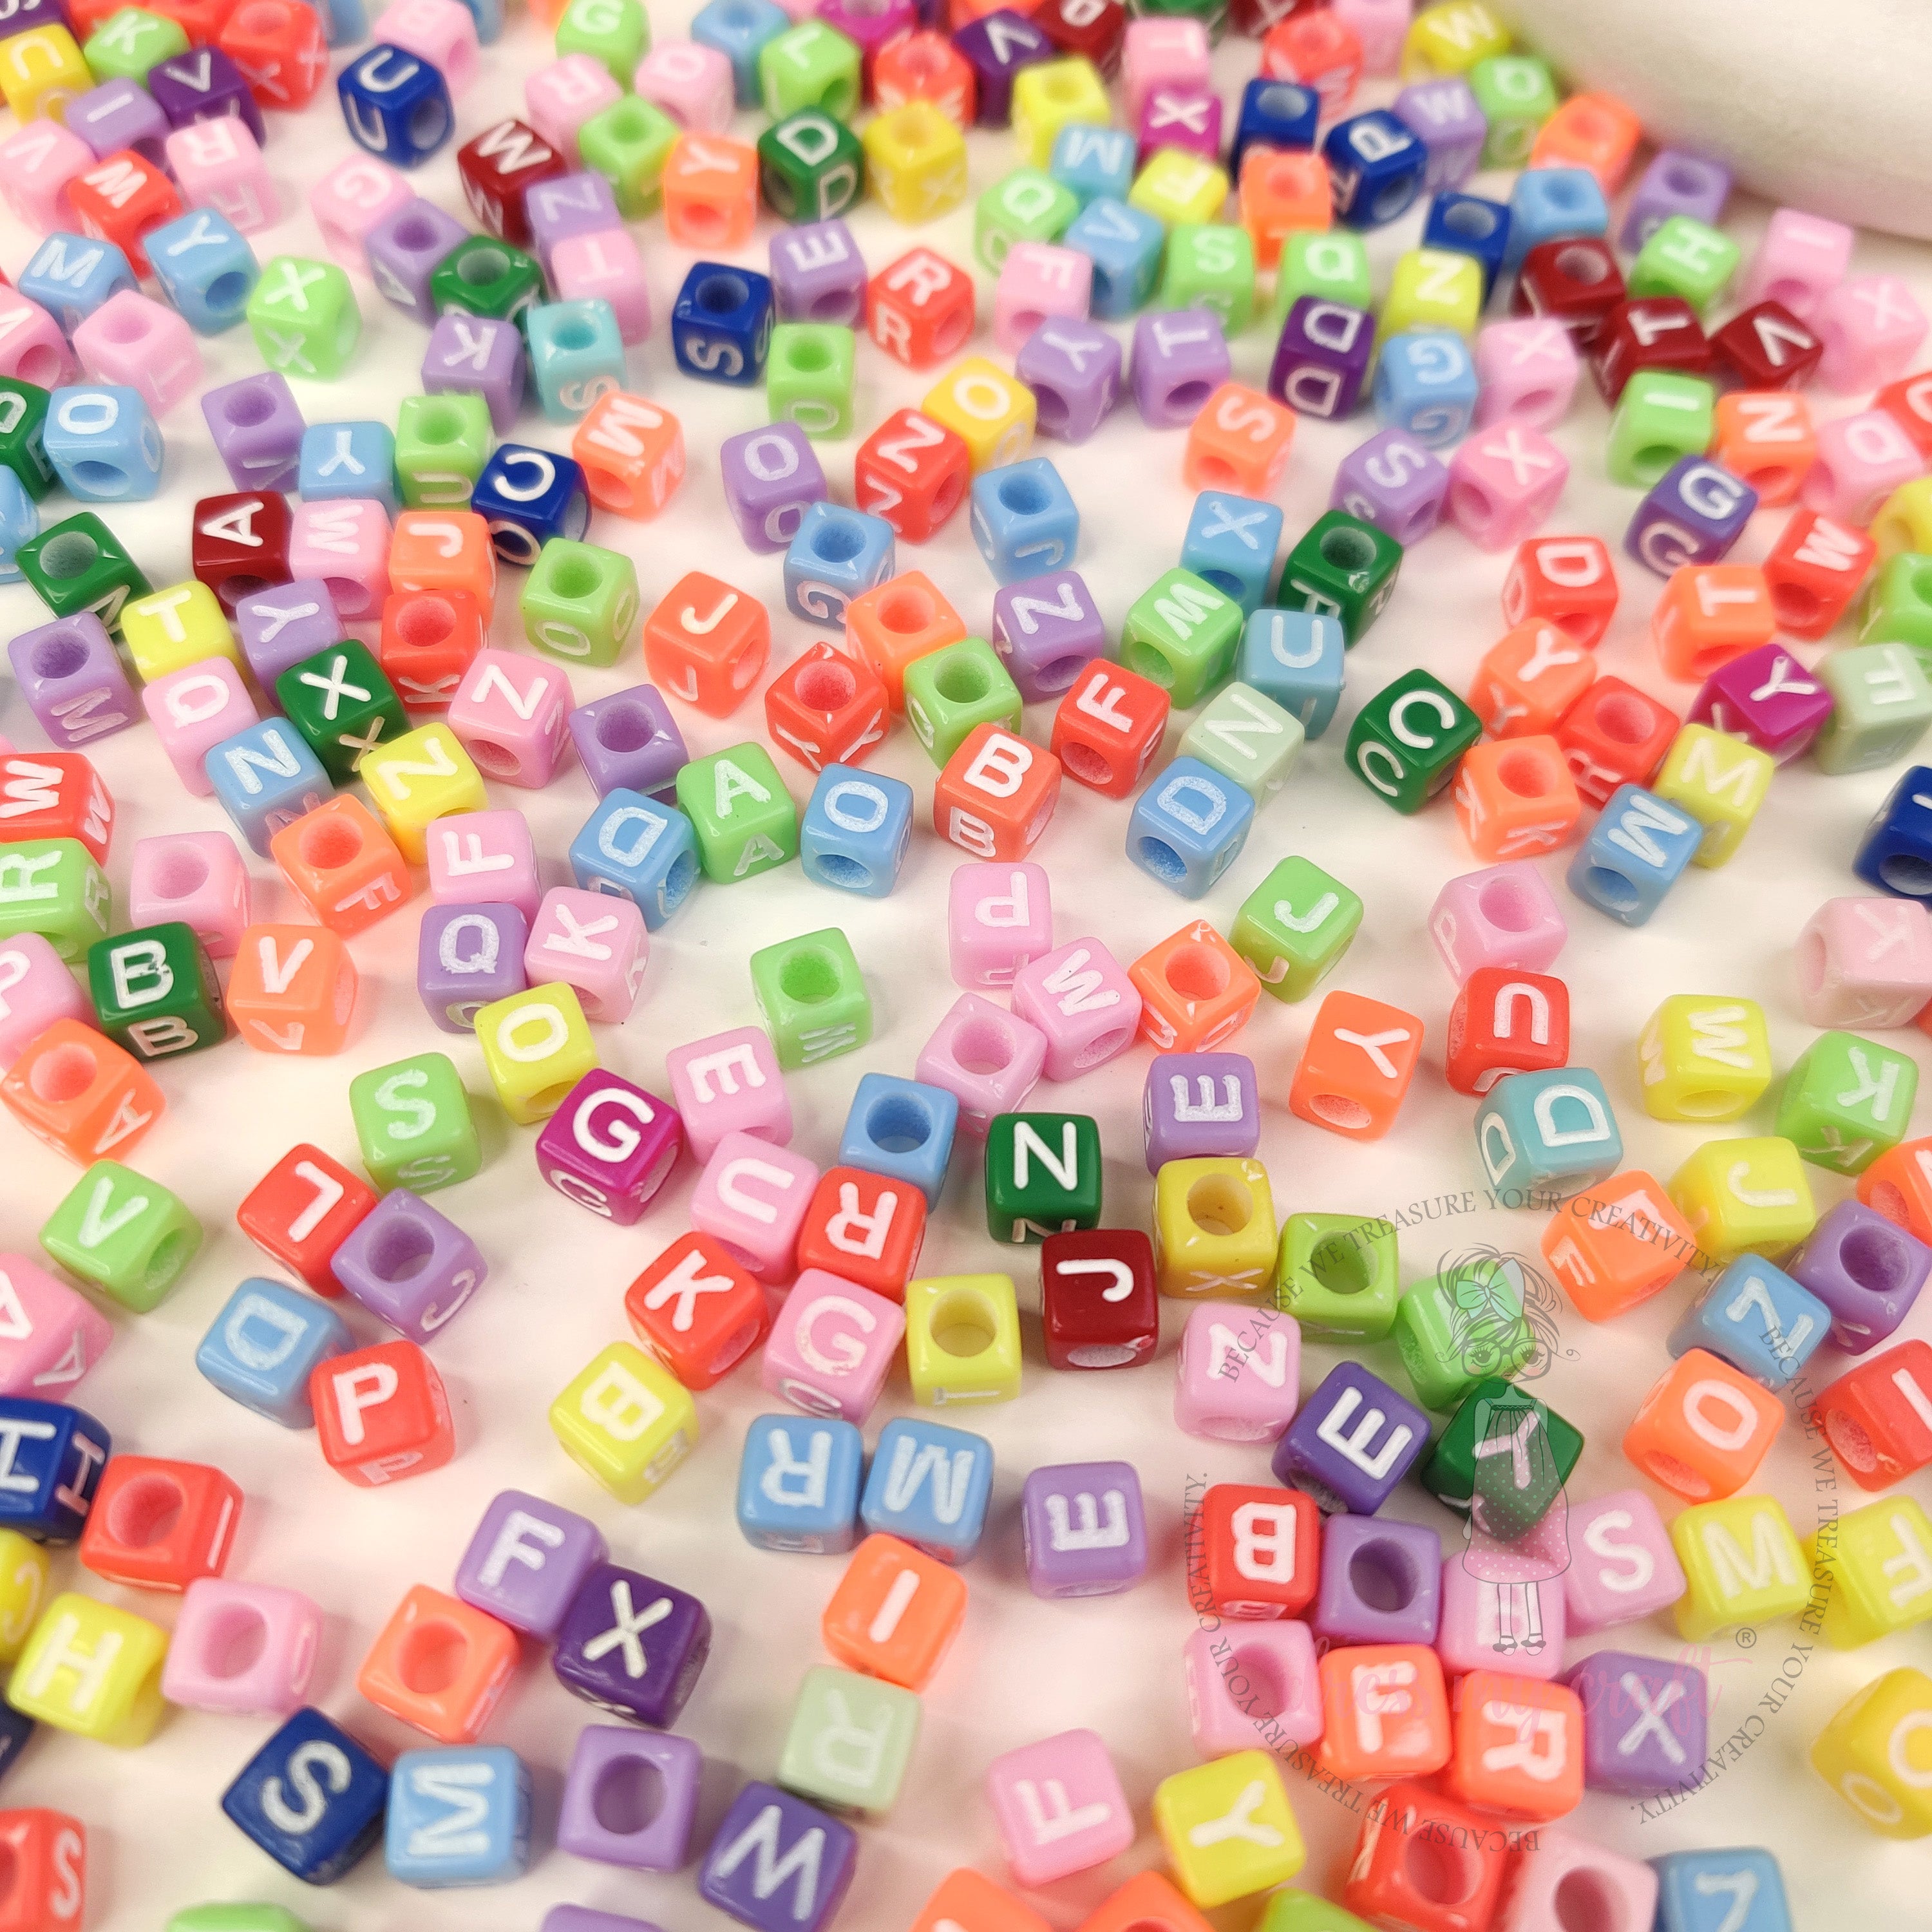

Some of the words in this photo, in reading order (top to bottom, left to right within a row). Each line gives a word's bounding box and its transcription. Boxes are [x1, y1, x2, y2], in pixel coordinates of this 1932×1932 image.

[100, 13, 158, 54] K
[163, 52, 211, 92] V
[359, 48, 420, 93] U
[1150, 95, 1211, 133] X
[679, 142, 740, 175] Y
[777, 118, 837, 167] D
[1350, 124, 1412, 163] P
[820, 164, 858, 222] D
[167, 215, 229, 256] Y
[786, 231, 849, 272] E
[1193, 231, 1236, 273] S
[1660, 227, 1728, 274] H
[264, 262, 327, 312] X
[887, 256, 951, 307] R
[266, 329, 317, 374] X
[443, 323, 497, 371] K
[875, 302, 912, 363] R
[1041, 332, 1103, 373] Y
[1151, 323, 1210, 357] T
[1305, 303, 1363, 353] D
[1627, 310, 1690, 346] T
[1754, 317, 1814, 366] V
[686, 339, 744, 376] S
[58, 394, 118, 433] O
[954, 375, 1010, 419] O
[1287, 366, 1340, 416] D
[1217, 397, 1276, 442] S
[319, 431, 365, 476] Y
[494, 453, 555, 501] C
[744, 435, 799, 480] O
[1366, 443, 1425, 488] S
[1484, 429, 1553, 486] X
[414, 472, 473, 503] U
[1678, 466, 1744, 520] G
[201, 502, 264, 547] A
[409, 524, 463, 558] J
[1201, 502, 1268, 550] X
[1015, 540, 1064, 565] J
[1536, 545, 1600, 587] D
[139, 590, 192, 642] T
[681, 594, 738, 634] J
[1695, 573, 1758, 617] T
[252, 603, 319, 643] Y
[1271, 616, 1323, 668] U
[1518, 629, 1581, 681] Y
[1749, 656, 1817, 701] Y
[301, 655, 371, 720] X
[1077, 674, 1132, 733] F
[840, 708, 883, 763] Y
[1389, 691, 1455, 749] C
[715, 760, 770, 819] A
[963, 733, 1032, 798] B
[1358, 741, 1403, 797] C
[824, 781, 888, 832] O
[949, 806, 997, 857] B
[1158, 776, 1226, 835] D
[443, 831, 515, 876] F
[734, 833, 785, 876] A
[335, 873, 401, 913] F
[975, 871, 1030, 927] P
[1274, 892, 1339, 933] J
[439, 914, 500, 974] Q
[543, 904, 620, 961] K
[111, 940, 175, 1009] B
[259, 936, 314, 993] V
[1244, 954, 1289, 984] J
[128, 1016, 199, 1057] B
[497, 1004, 568, 1062] O
[1493, 983, 1548, 1045] U
[687, 1043, 766, 1103] E
[1334, 1028, 1410, 1078] Y
[374, 1069, 437, 1140] S
[1170, 1075, 1243, 1122] E
[1837, 1046, 1899, 1121] K
[94, 1089, 153, 1155] A
[573, 1088, 655, 1163] G
[1533, 1084, 1611, 1148] D
[1013, 1121, 1077, 1191] N
[1481, 1112, 1516, 1186] D
[287, 1160, 343, 1242] L
[717, 1159, 795, 1224] U
[1727, 1162, 1797, 1207] J
[78, 1177, 149, 1248] V
[825, 1182, 898, 1260] R
[643, 1249, 735, 1332] K
[1056, 1258, 1133, 1302] J
[1186, 1269, 1264, 1291] X
[226, 1294, 308, 1370] D
[795, 1294, 877, 1376] G
[333, 1363, 398, 1445] P
[581, 1361, 665, 1441] B
[1683, 1379, 1757, 1451] O
[1316, 1387, 1414, 1480] E
[761, 1428, 833, 1507] R
[1045, 1489, 1130, 1552] E
[1232, 1502, 1296, 1584] B
[480, 1510, 565, 1586] F
[1584, 1510, 1655, 1593] S
[1701, 1512, 1797, 1600] M
[583, 1579, 673, 1678] X
[868, 1569, 920, 1643] I
[28, 1613, 122, 1713] H
[1352, 1661, 1416, 1754] F
[1618, 1672, 1687, 1765] X
[813, 1689, 894, 1787] R
[1481, 1700, 1566, 1782] R
[262, 1741, 351, 1833] S
[1014, 1779, 1110, 1846] F
[1188, 1781, 1285, 1848] Y
[52, 1829, 82, 1919] S
